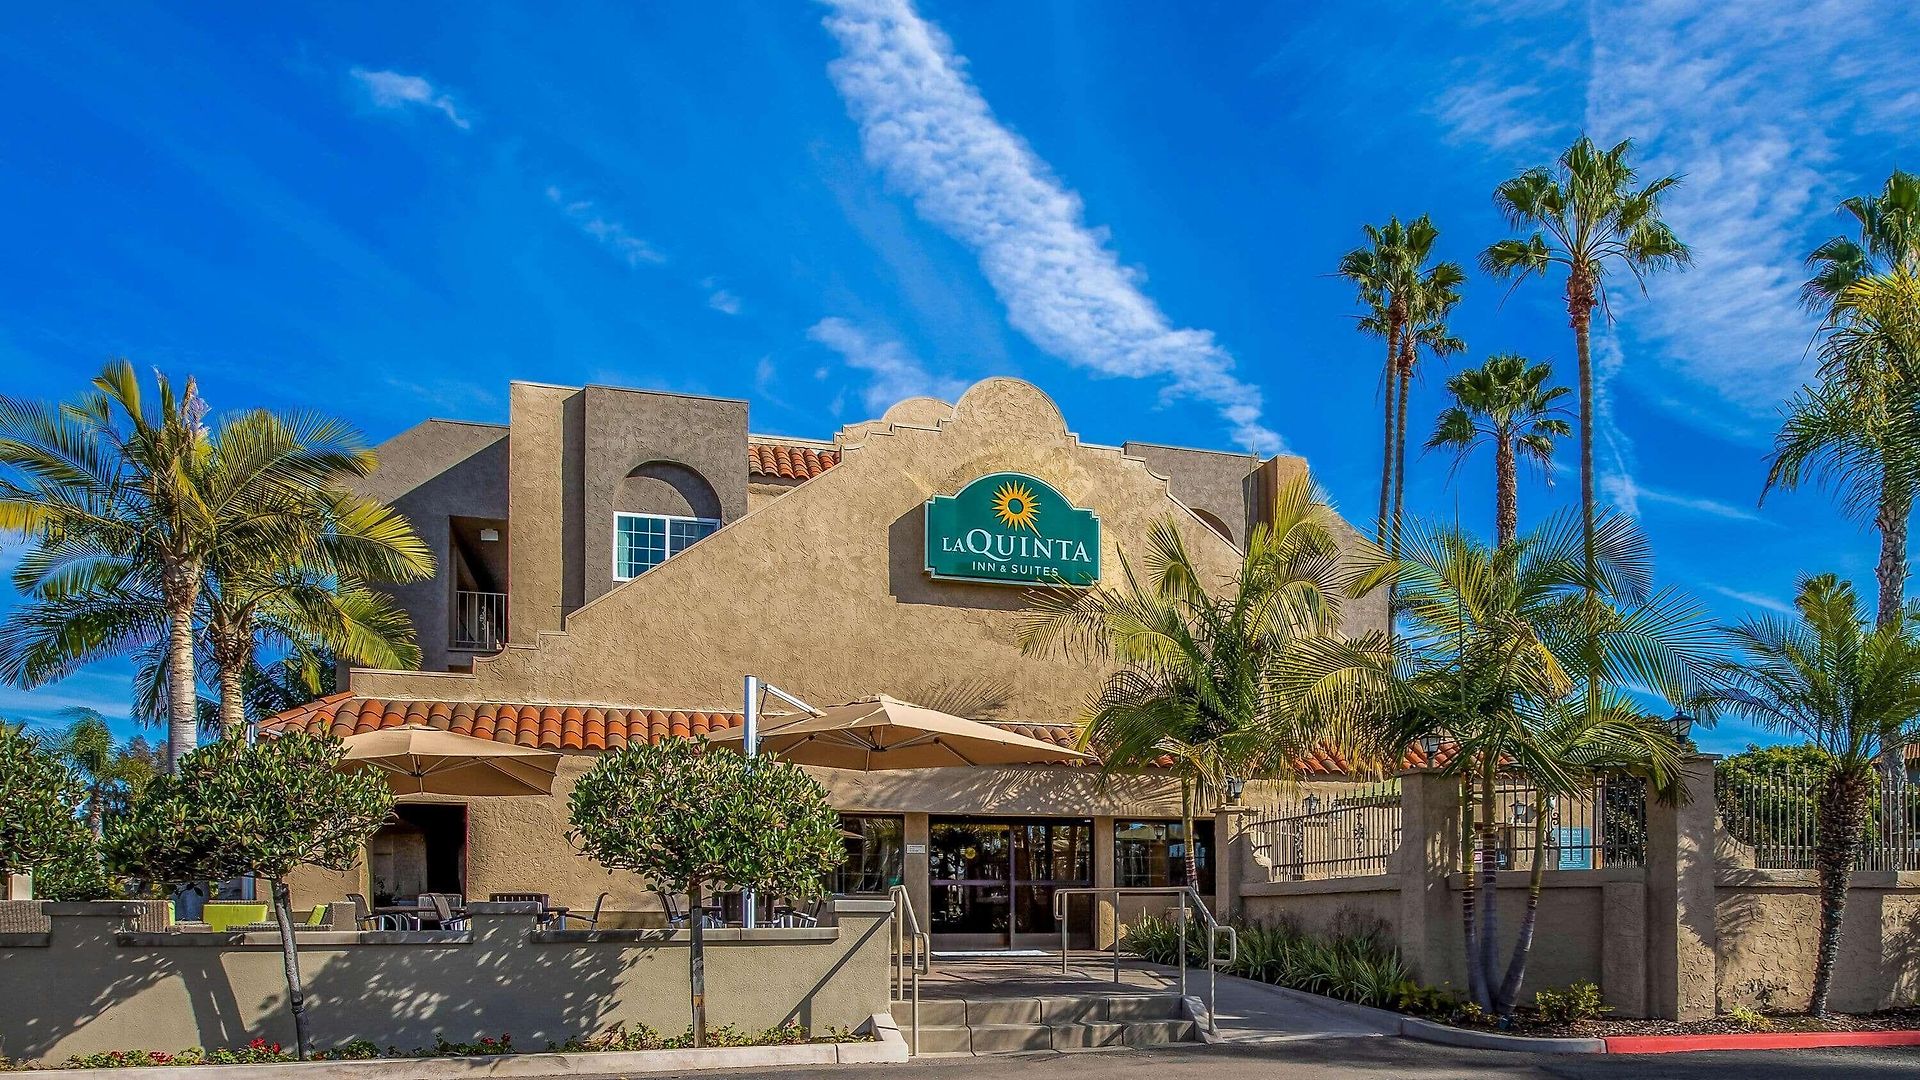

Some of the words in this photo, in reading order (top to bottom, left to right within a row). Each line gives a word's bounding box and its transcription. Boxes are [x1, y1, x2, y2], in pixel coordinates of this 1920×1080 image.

[942, 537, 967, 553] LA
[966, 528, 1091, 562] QUINTA
[972, 560, 996, 572] INN
[999, 564, 1007, 573] &
[1011, 564, 1059, 577] SUITES
